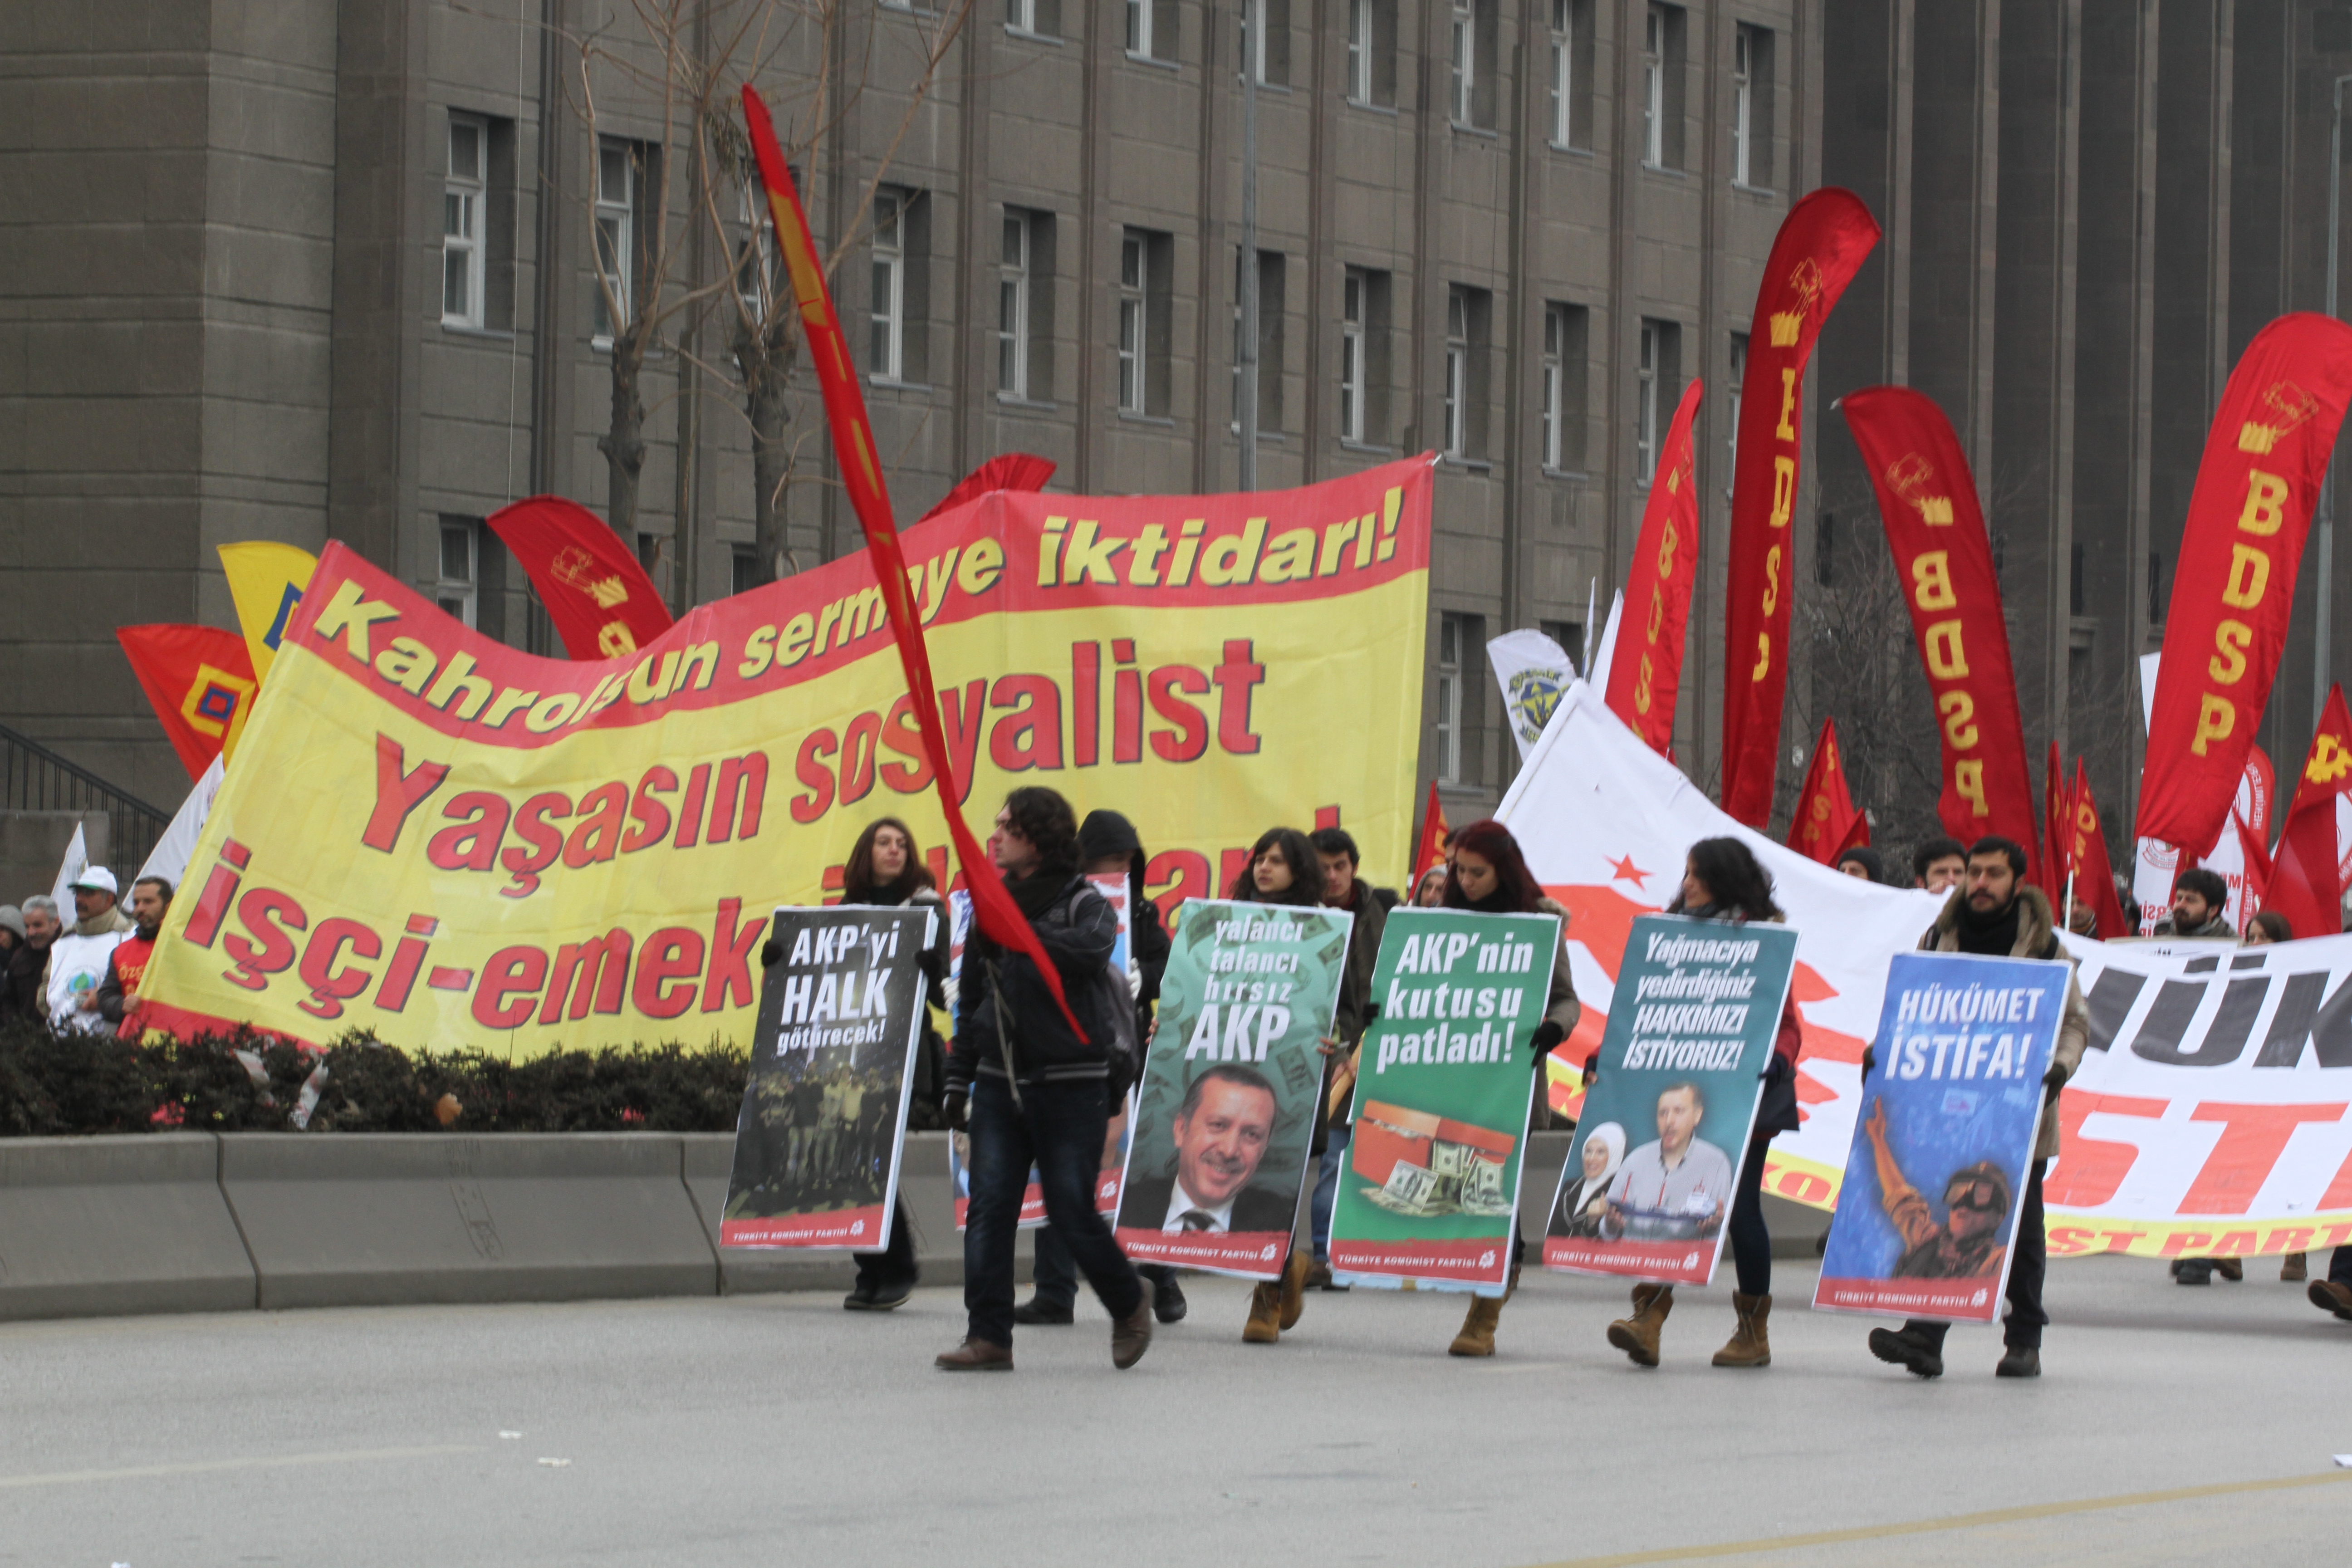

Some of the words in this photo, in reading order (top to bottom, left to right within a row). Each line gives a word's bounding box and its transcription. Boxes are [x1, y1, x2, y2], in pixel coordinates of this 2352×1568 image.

[313, 578, 720, 734] Kahrolsun
[1037, 486, 1405, 588] iktidarı!
[2191, 468, 2288, 757] BDSP
[362, 731, 768, 898] Yaşasın
[789, 920, 900, 970] AKP'yi
[1215, 913, 1303, 946] yalancı
[1644, 931, 1760, 969] Yağmacıya
[1209, 945, 1299, 974] talancı
[1395, 931, 1534, 975] AKP'nin
[780, 967, 892, 1025] HALK
[1203, 974, 1293, 1003] hırsız
[1384, 978, 1523, 1020] kutusu
[1633, 968, 1757, 1006] yedirdiğiniz
[1898, 982, 2045, 1024] HÜKÜMET
[776, 1019, 886, 1057] götürecek!
[1185, 1004, 1291, 1063] AKP
[1632, 1004, 1750, 1035] HAKKIMIZI
[1376, 1021, 1516, 1074] patladı!
[1622, 1032, 1745, 1071] İSTİYORUZ!
[1885, 1024, 2033, 1080] İSTİFA!
